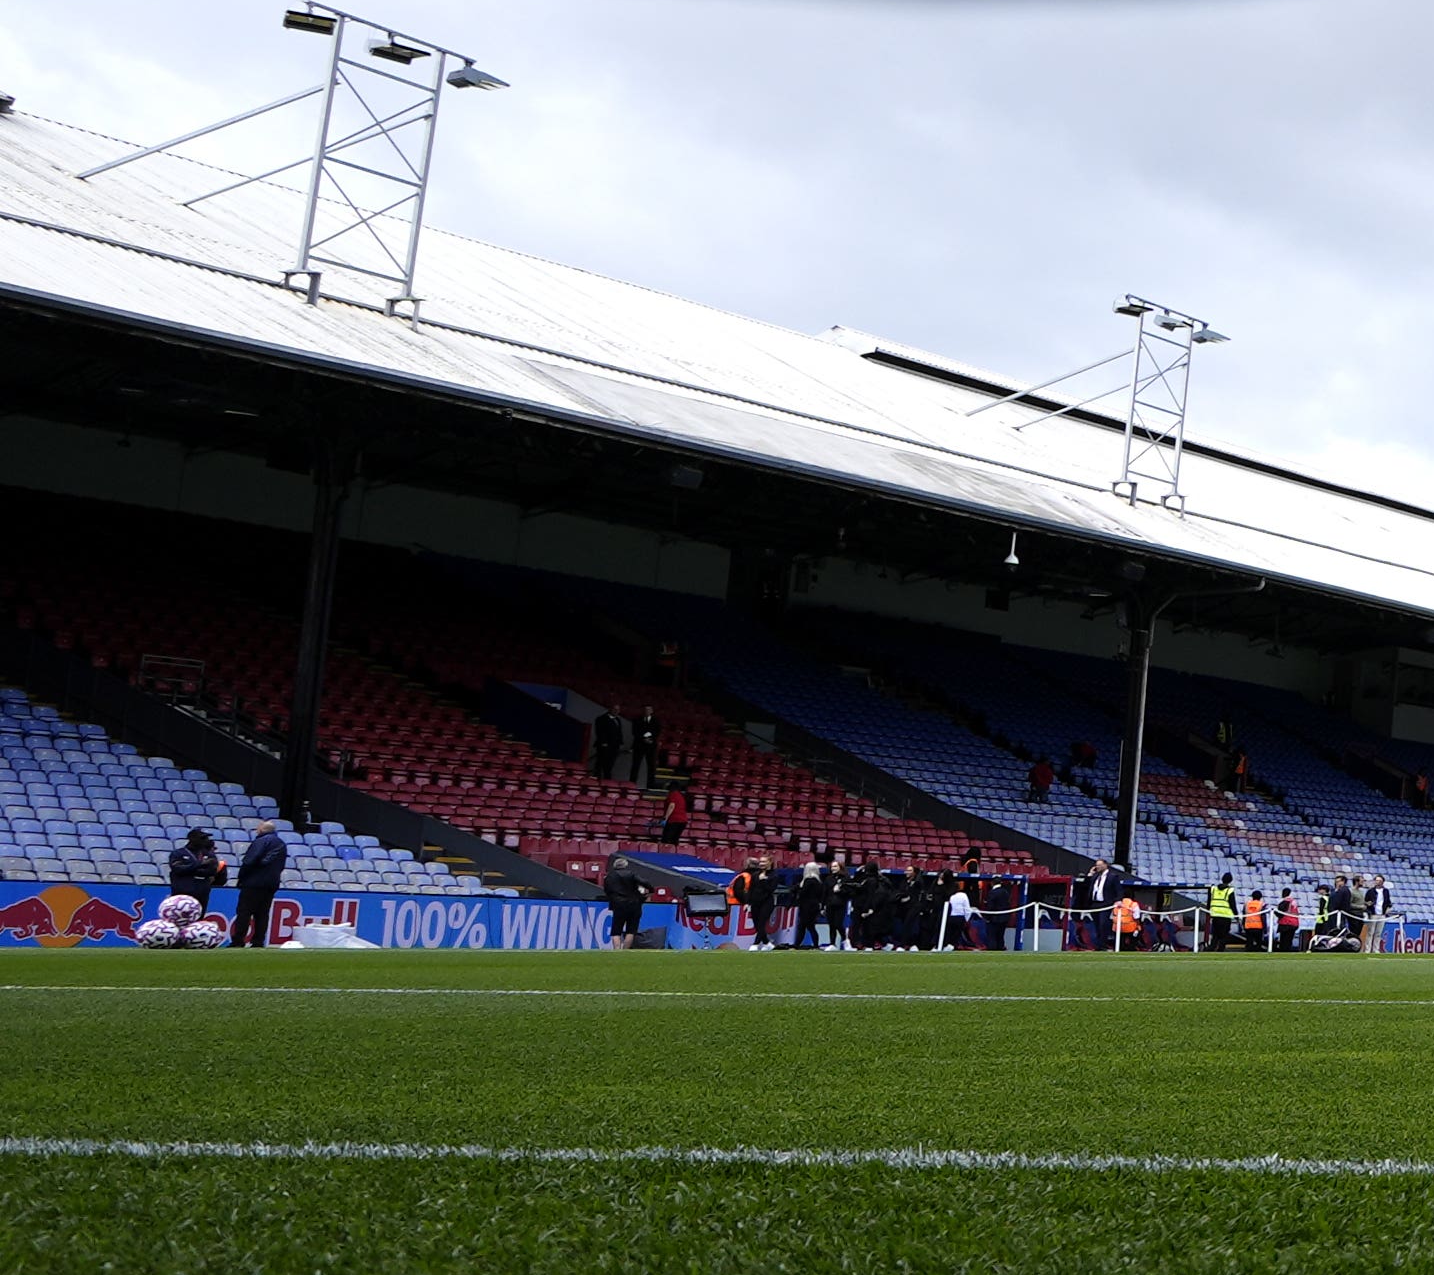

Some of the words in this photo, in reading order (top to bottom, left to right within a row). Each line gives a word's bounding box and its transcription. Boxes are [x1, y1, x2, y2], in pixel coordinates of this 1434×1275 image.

[265, 898, 360, 947] Bll
[381, 900, 487, 949] 100%
[502, 904, 614, 950] WIIING
